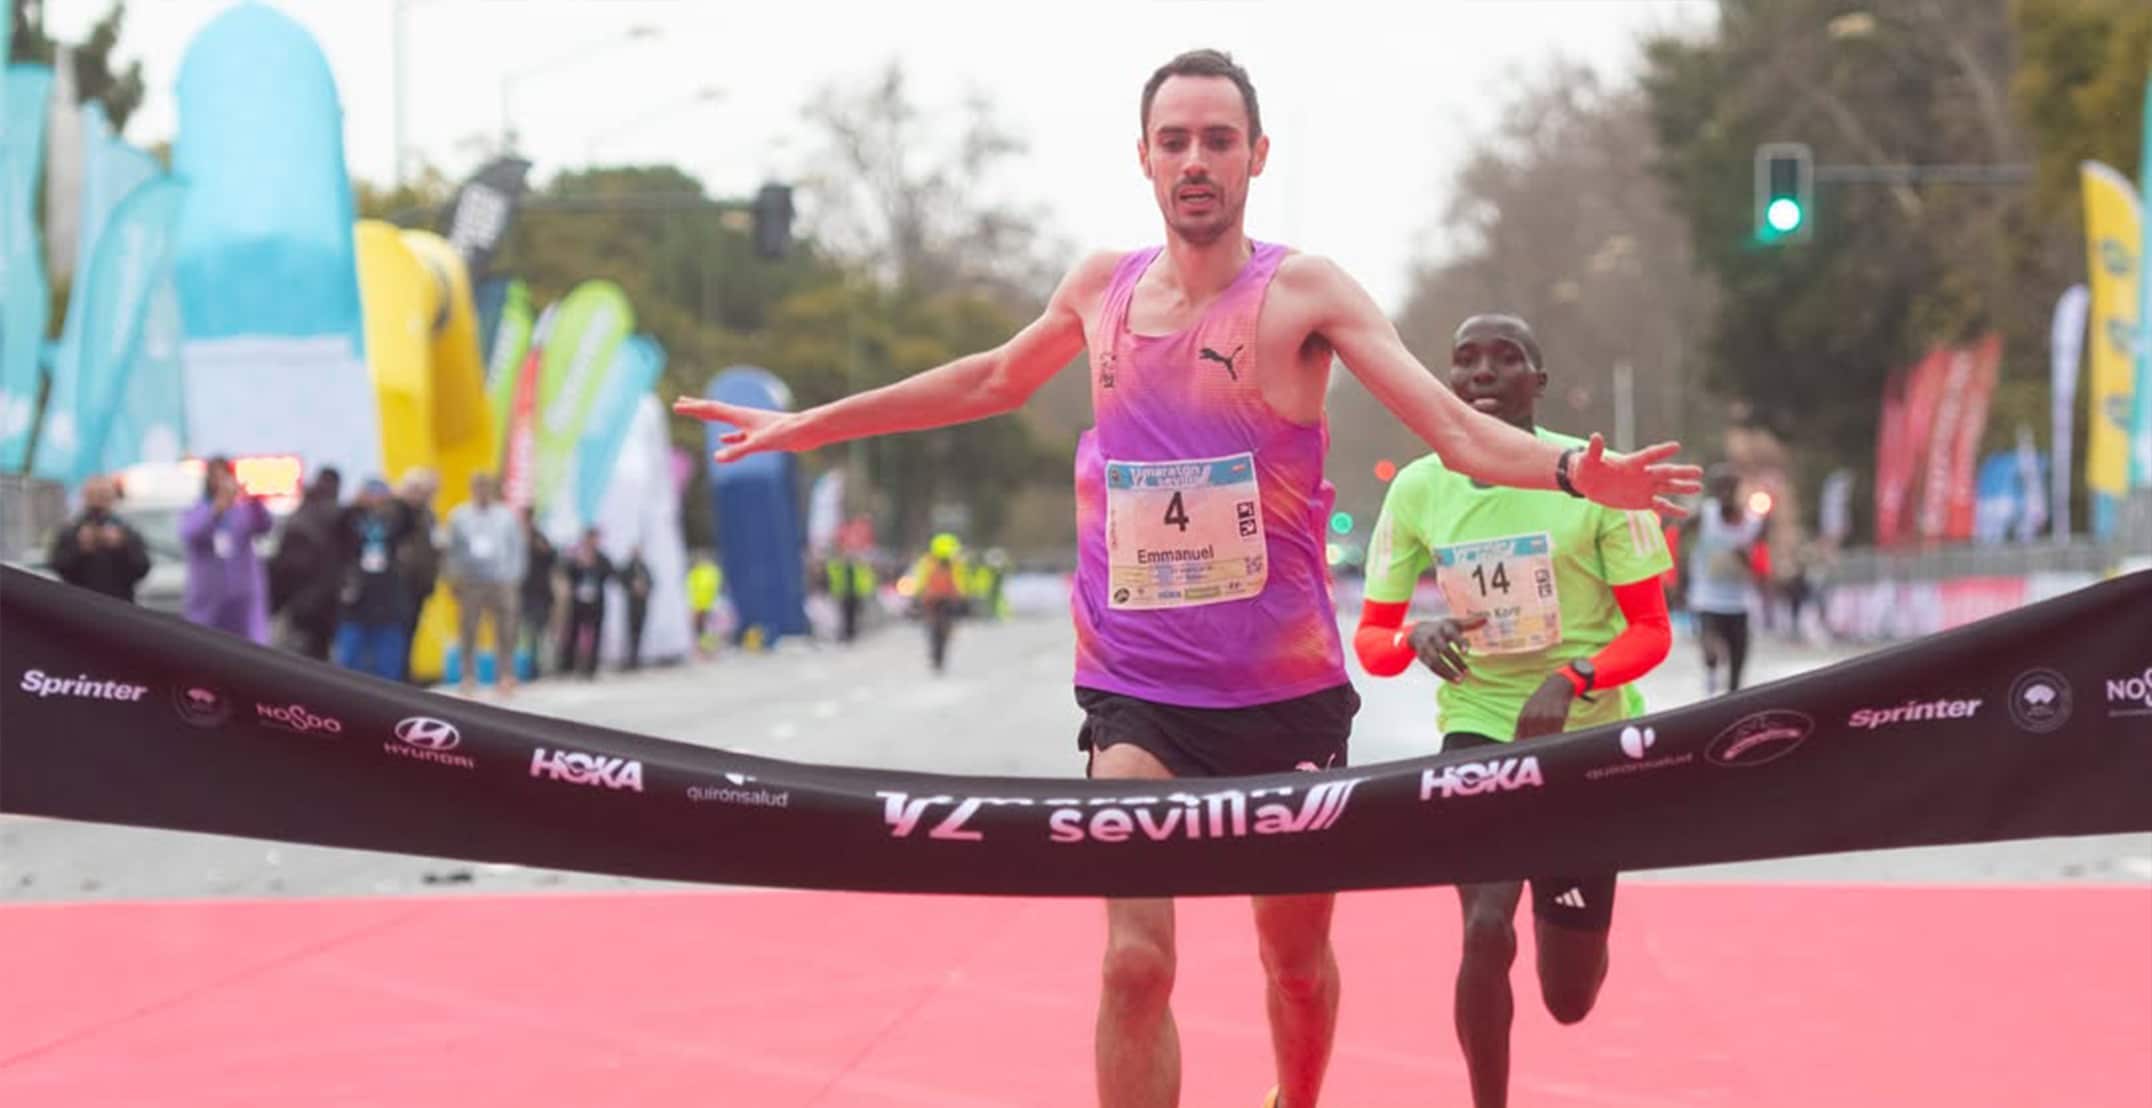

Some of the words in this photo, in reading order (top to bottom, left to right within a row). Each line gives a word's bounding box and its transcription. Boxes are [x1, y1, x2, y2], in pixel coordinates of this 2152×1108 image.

[1164, 491, 1189, 532] 4
[1137, 545, 1214, 564] Emmanuel
[1472, 562, 1510, 597] 14
[21, 669, 148, 701] Sprinter
[1850, 698, 1982, 729] Sprinter
[530, 748, 644, 792] HOKA
[1420, 756, 1544, 800] HOKA
[1049, 791, 1302, 842] sevilla
